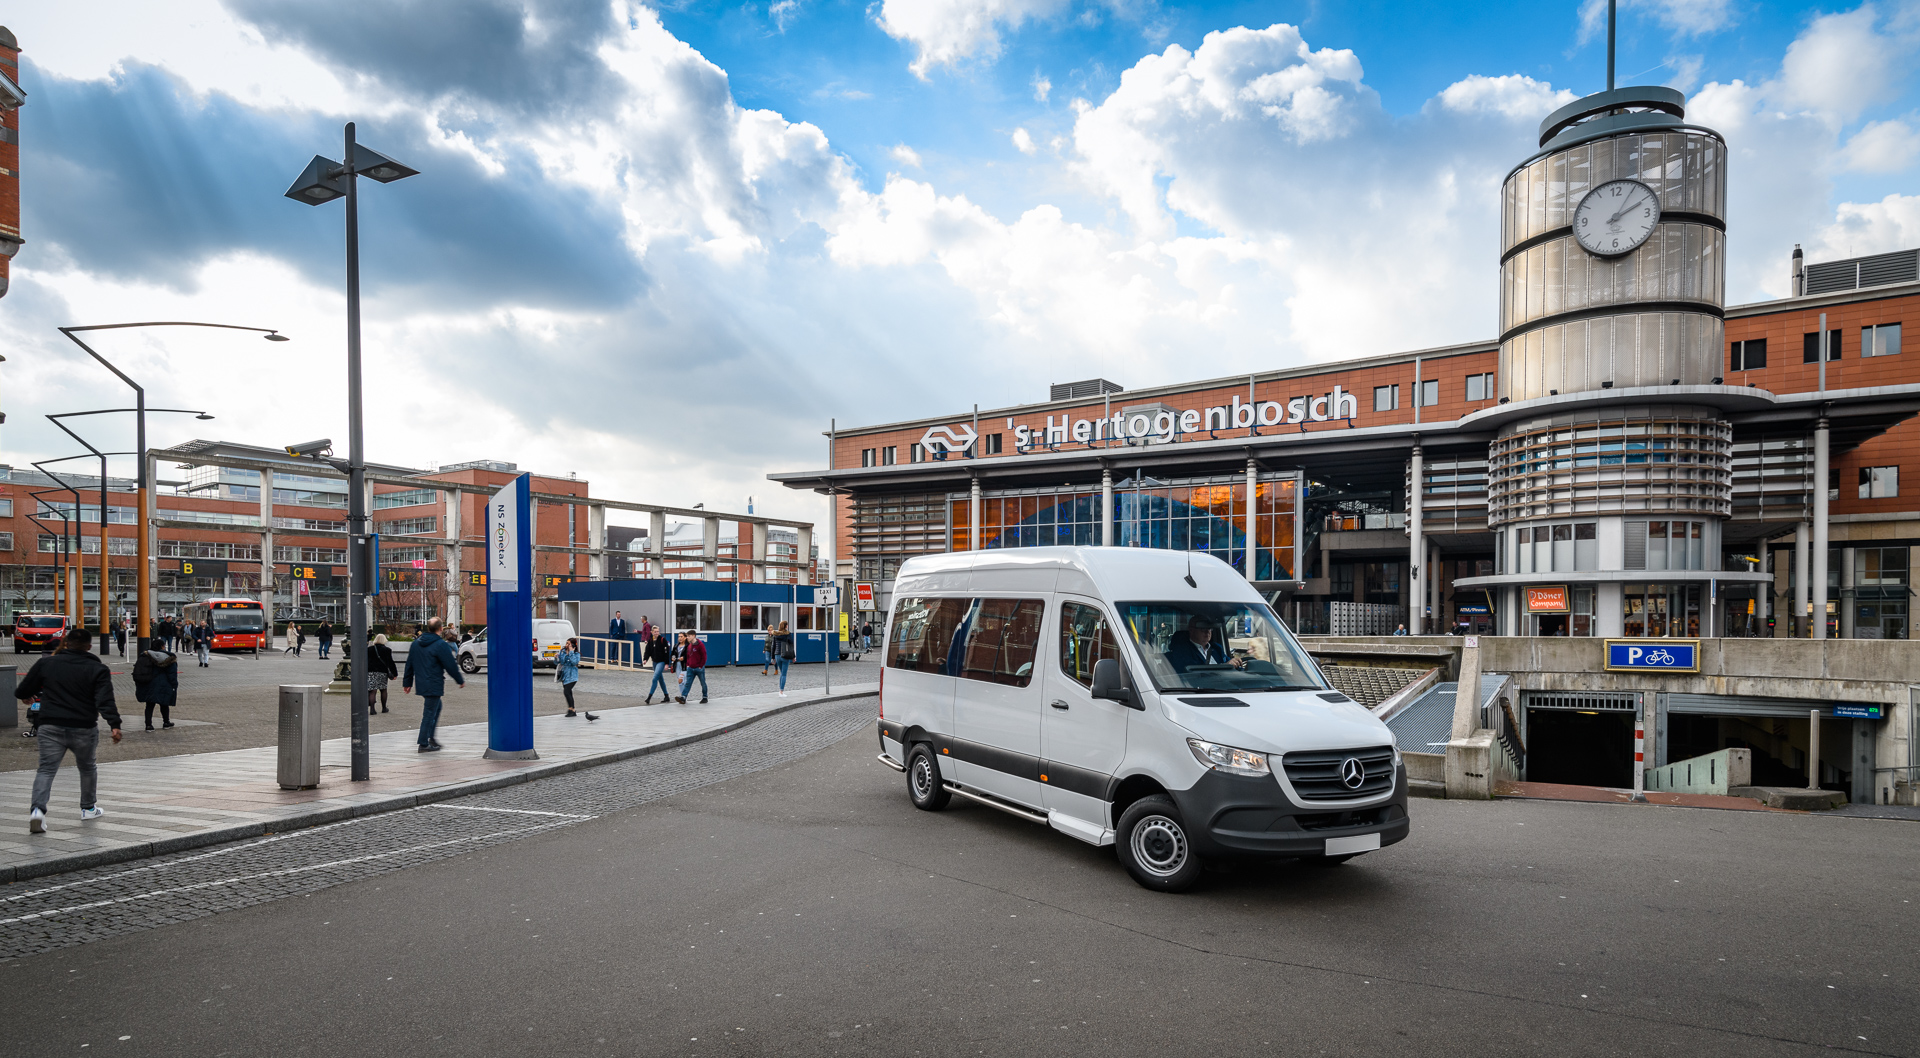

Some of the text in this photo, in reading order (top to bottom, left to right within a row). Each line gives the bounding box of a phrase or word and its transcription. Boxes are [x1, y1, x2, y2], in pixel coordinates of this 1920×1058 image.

[1610, 187, 1622, 197] 12
[1644, 208, 1650, 218] 3
[1581, 217, 1588, 227] 9
[1612, 238, 1619, 248] 6
[1007, 385, 1357, 446] 's-Hertogenbosch
[497, 504, 505, 519] NS
[183, 563, 194, 574] B
[293, 567, 302, 578] C
[388, 571, 397, 581] D
[472, 574, 479, 584] E
[545, 577, 552, 586] F
[1537, 591, 1562, 600] Döner
[1530, 600, 1563, 608] Company
[1628, 647, 1643, 665] P
